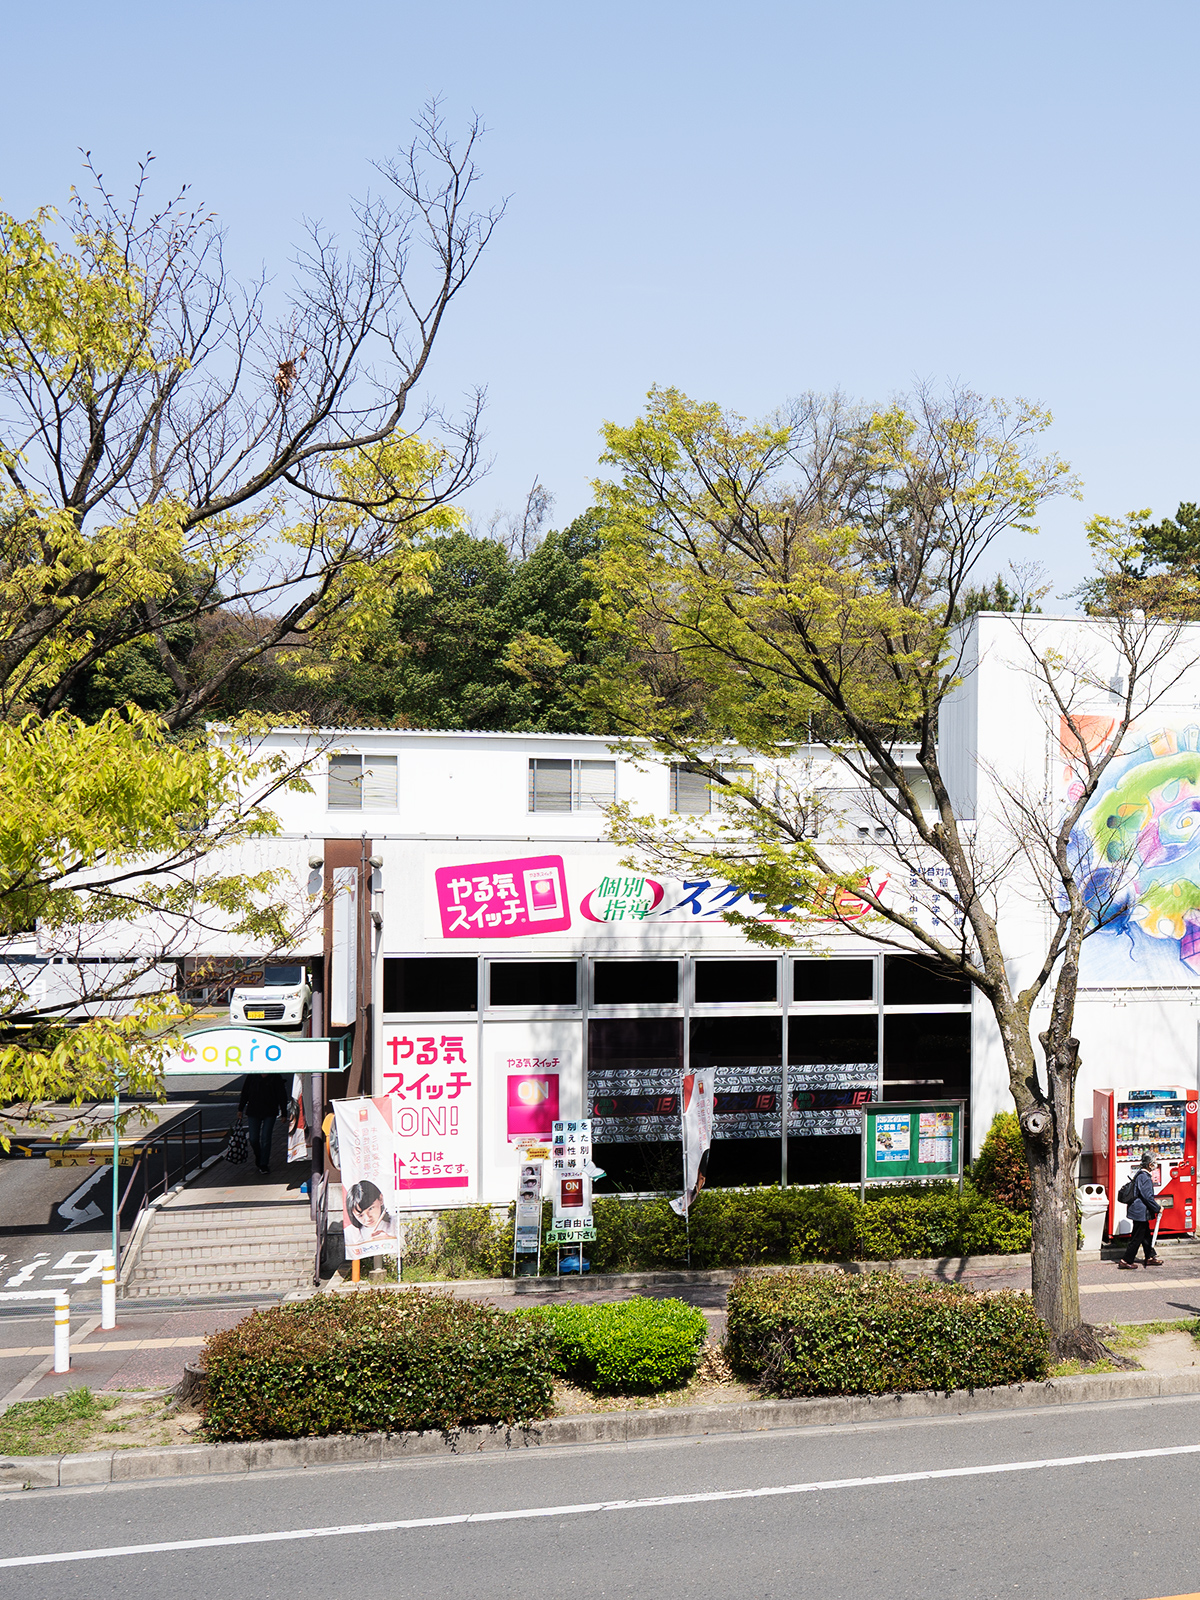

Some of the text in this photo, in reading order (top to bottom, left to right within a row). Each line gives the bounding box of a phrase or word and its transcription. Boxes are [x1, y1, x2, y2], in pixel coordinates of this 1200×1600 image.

[447, 873, 519, 905] やる気
[598, 876, 648, 898] 個別
[603, 899, 652, 921] 指導
[447, 900, 525, 932] スイッチ
[386, 1035, 467, 1066] やる気
[507, 1058, 560, 1068] やる気スイッチ
[383, 1072, 471, 1100] スイッチ
[518, 1081, 549, 1099] ON
[554, 1122, 588, 1132] 個別を
[554, 1134, 589, 1144] 超えた
[554, 1146, 589, 1156] 個性別
[409, 1151, 444, 1163] 入口は
[409, 1164, 469, 1175] こちらです。
[565, 1182, 579, 1190] ON
[555, 1219, 592, 1228] ご自由に
[548, 1231, 596, 1242] お取り下さい
